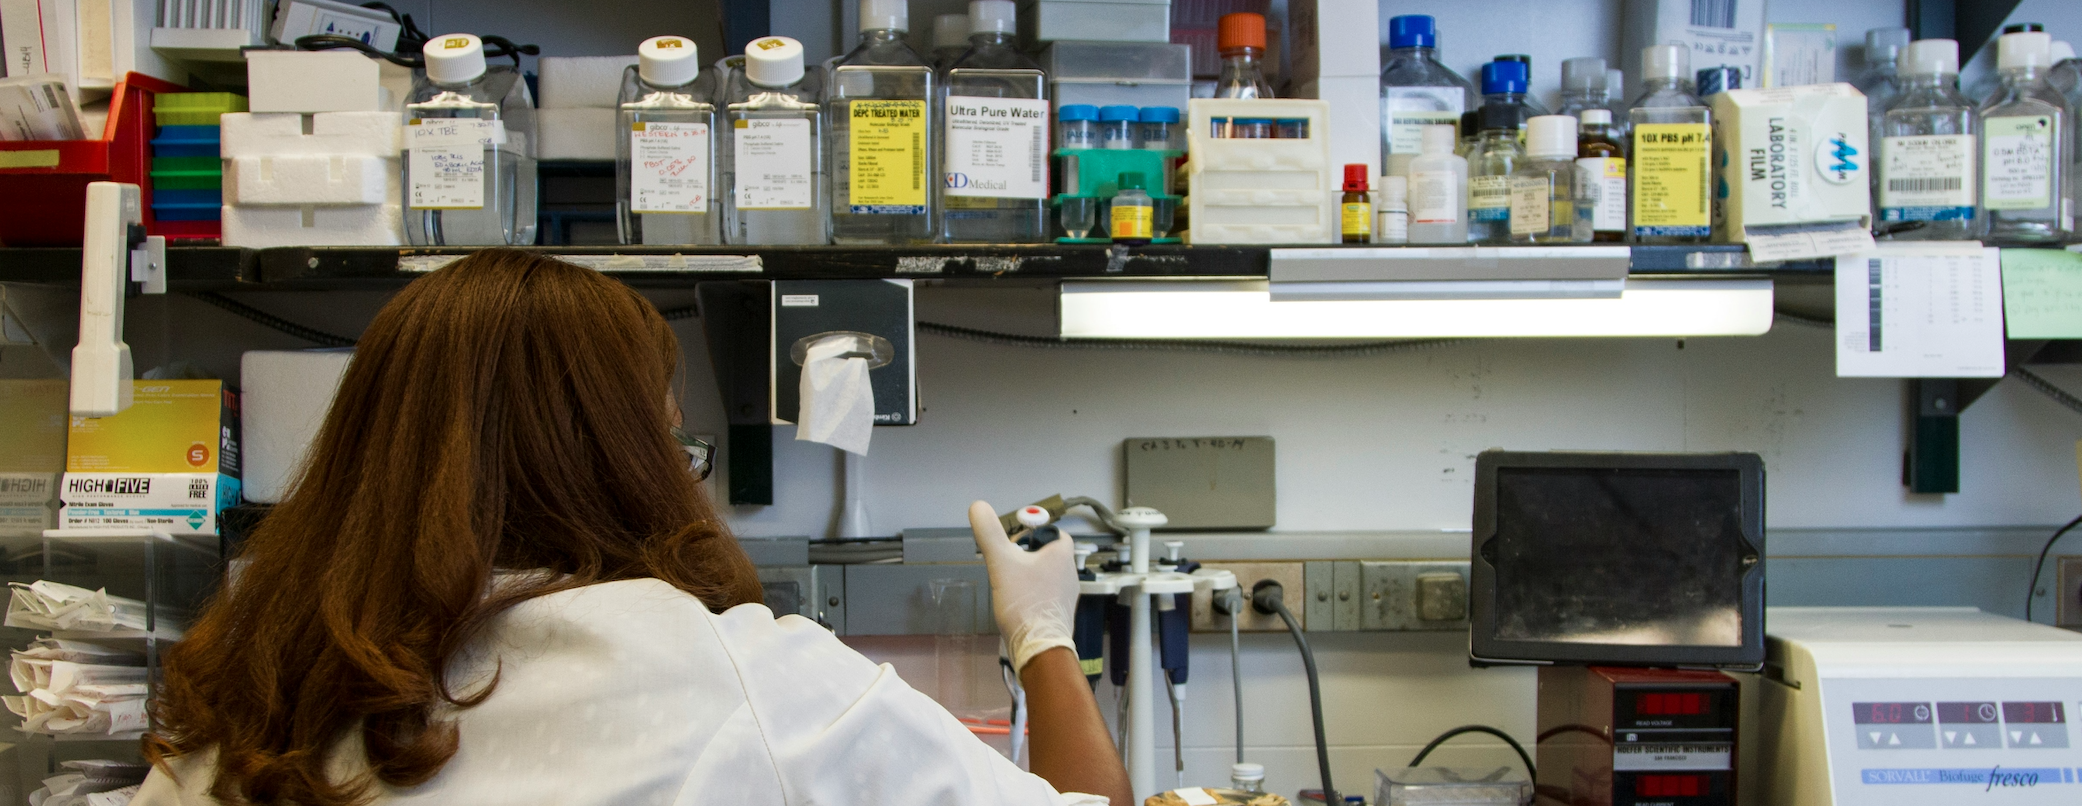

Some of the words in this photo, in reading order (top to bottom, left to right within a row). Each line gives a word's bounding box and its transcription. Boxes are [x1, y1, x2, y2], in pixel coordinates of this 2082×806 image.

[853, 109, 869, 118] DEPC
[871, 109, 898, 118] TREATED
[900, 109, 921, 118] WATER
[950, 105, 977, 116] Ultra
[981, 106, 1007, 117] Pure
[1011, 107, 1045, 118] Water
[437, 127, 458, 136] TBE
[1642, 133, 1658, 143] 10X
[1661, 133, 1679, 143] PBS
[1682, 134, 1694, 145] pH
[1697, 133, 1711, 143] 7.4
[1751, 148, 1766, 181] FILM
[1769, 117, 1786, 209] LABORATORY
[968, 179, 1007, 189] Medical
[191, 450, 204, 461] S
[69, 479, 105, 493] HIGH
[115, 478, 150, 494] FIVE
[1871, 703, 1901, 723] 6.0
[2024, 703, 2035, 722] 3
[1617, 745, 1642, 754] HOEFER
[1645, 745, 1680, 753] SCIENTIFIC
[1683, 745, 1729, 753] INSTRUMENTS
[1939, 769, 1984, 786] Biofuge
[1986, 765, 2039, 792] fresco
